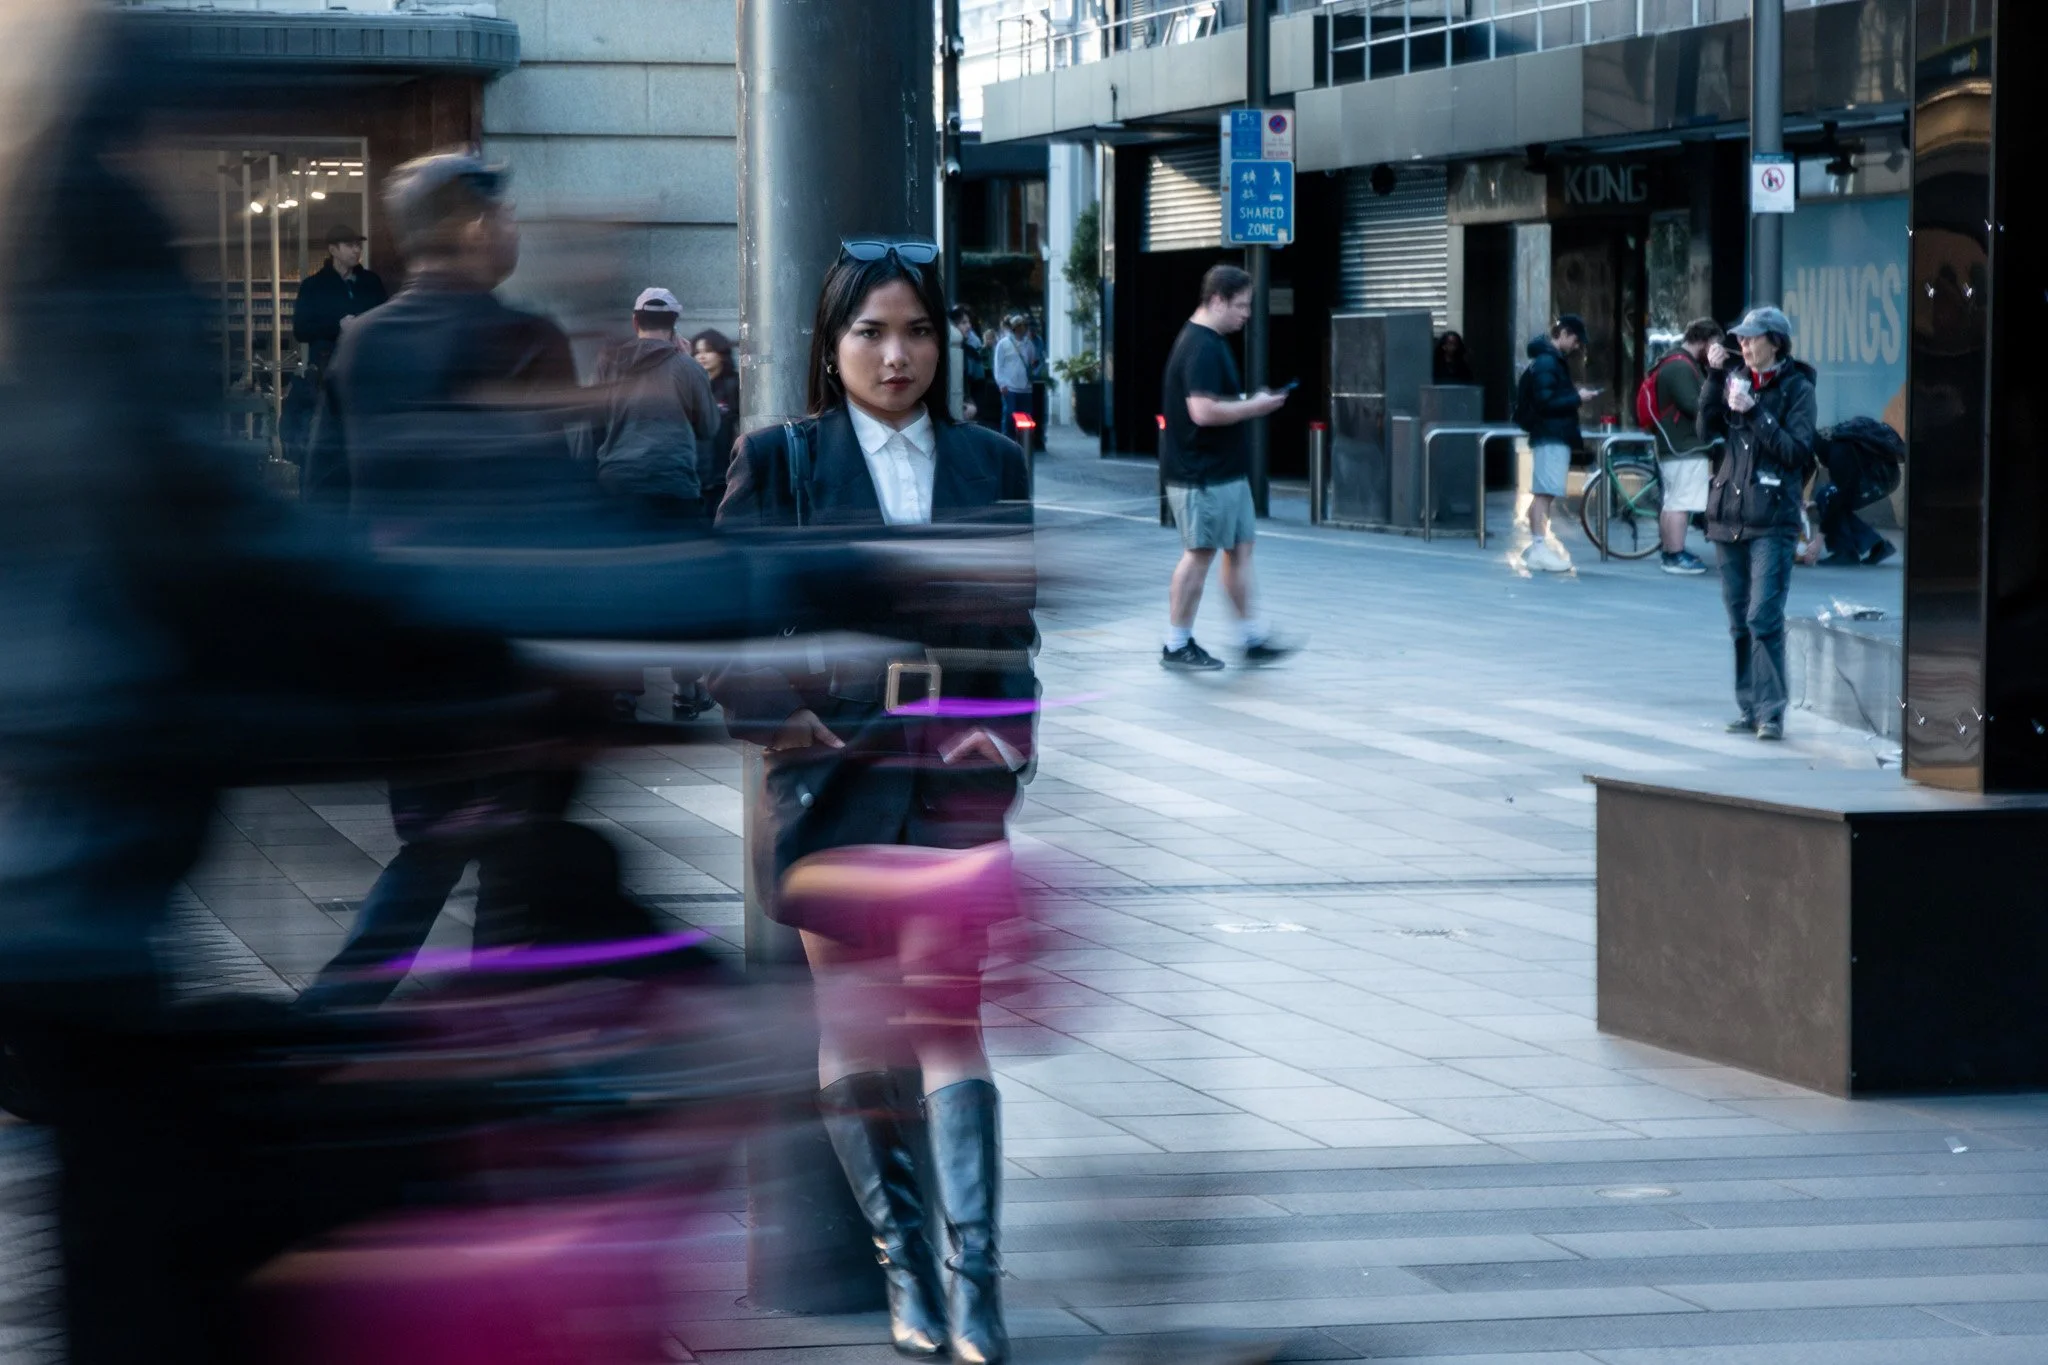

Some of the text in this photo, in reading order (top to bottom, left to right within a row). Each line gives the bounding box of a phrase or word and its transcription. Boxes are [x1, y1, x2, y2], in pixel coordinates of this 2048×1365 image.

[1564, 164, 1648, 204] KONG
[1240, 207, 1284, 219] SHARED
[1248, 223, 1276, 236] ZONE
